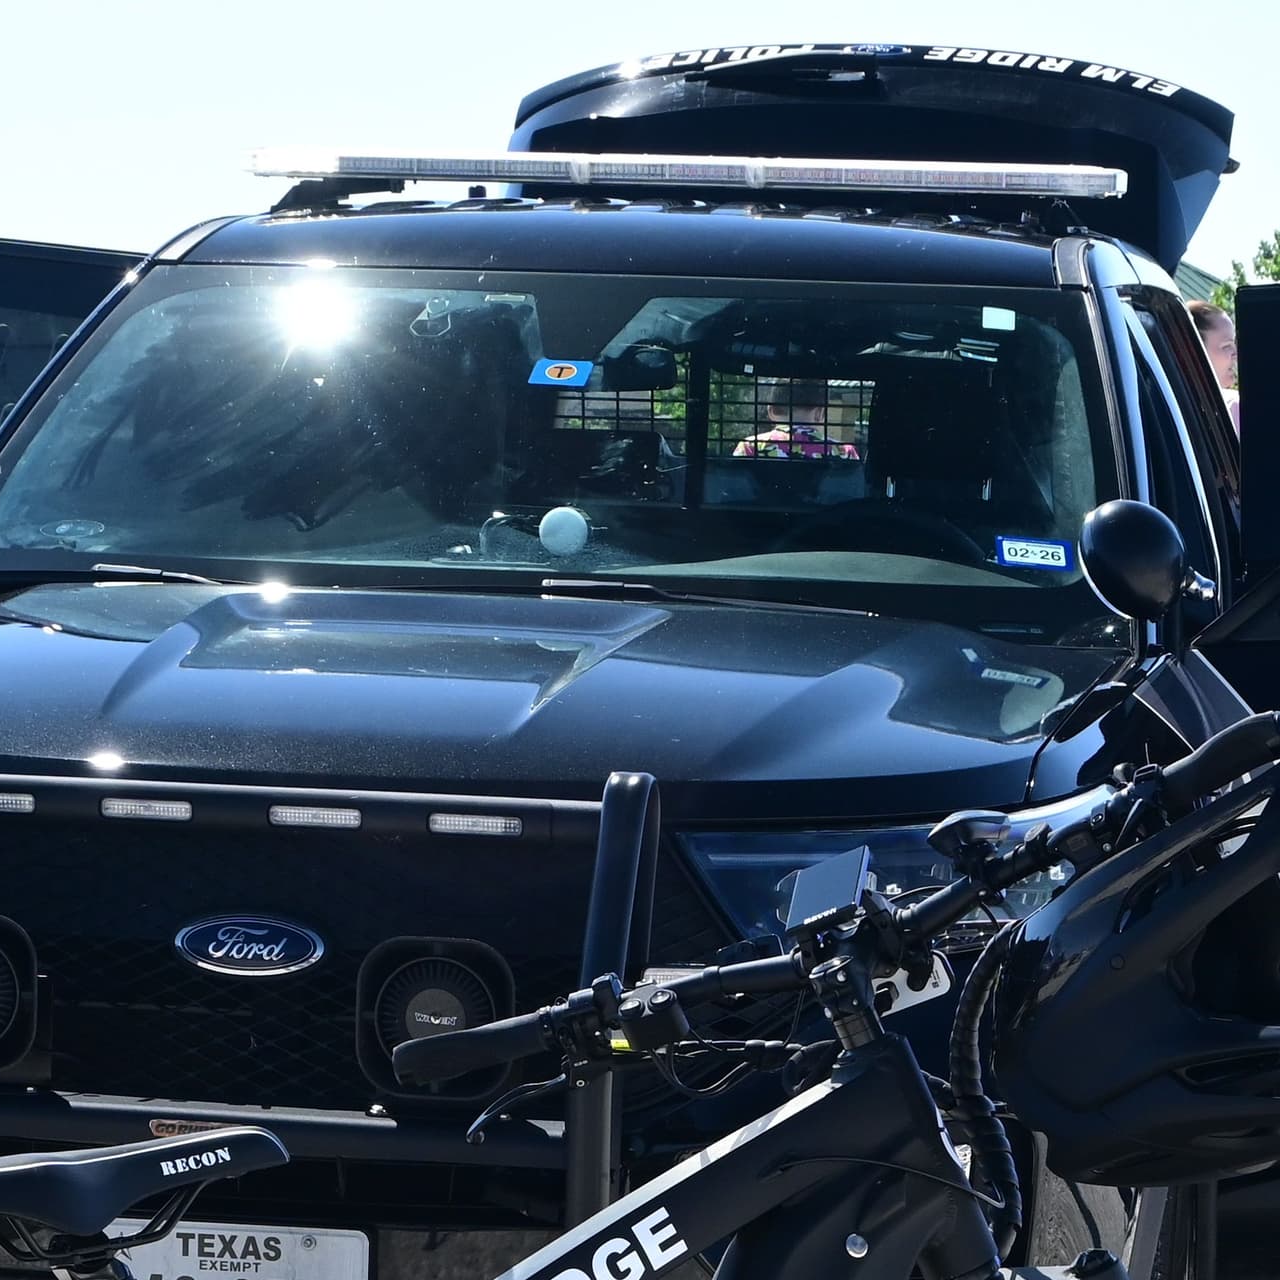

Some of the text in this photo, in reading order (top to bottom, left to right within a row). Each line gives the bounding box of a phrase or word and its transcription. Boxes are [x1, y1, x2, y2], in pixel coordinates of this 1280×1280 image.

[923, 46, 1182, 97] ELM RIDGE
[207, 927, 288, 962] Ford
[160, 1147, 232, 1176] RECON
[176, 1232, 282, 1262] TEXAS
[199, 1260, 262, 1273] EXEMPT
